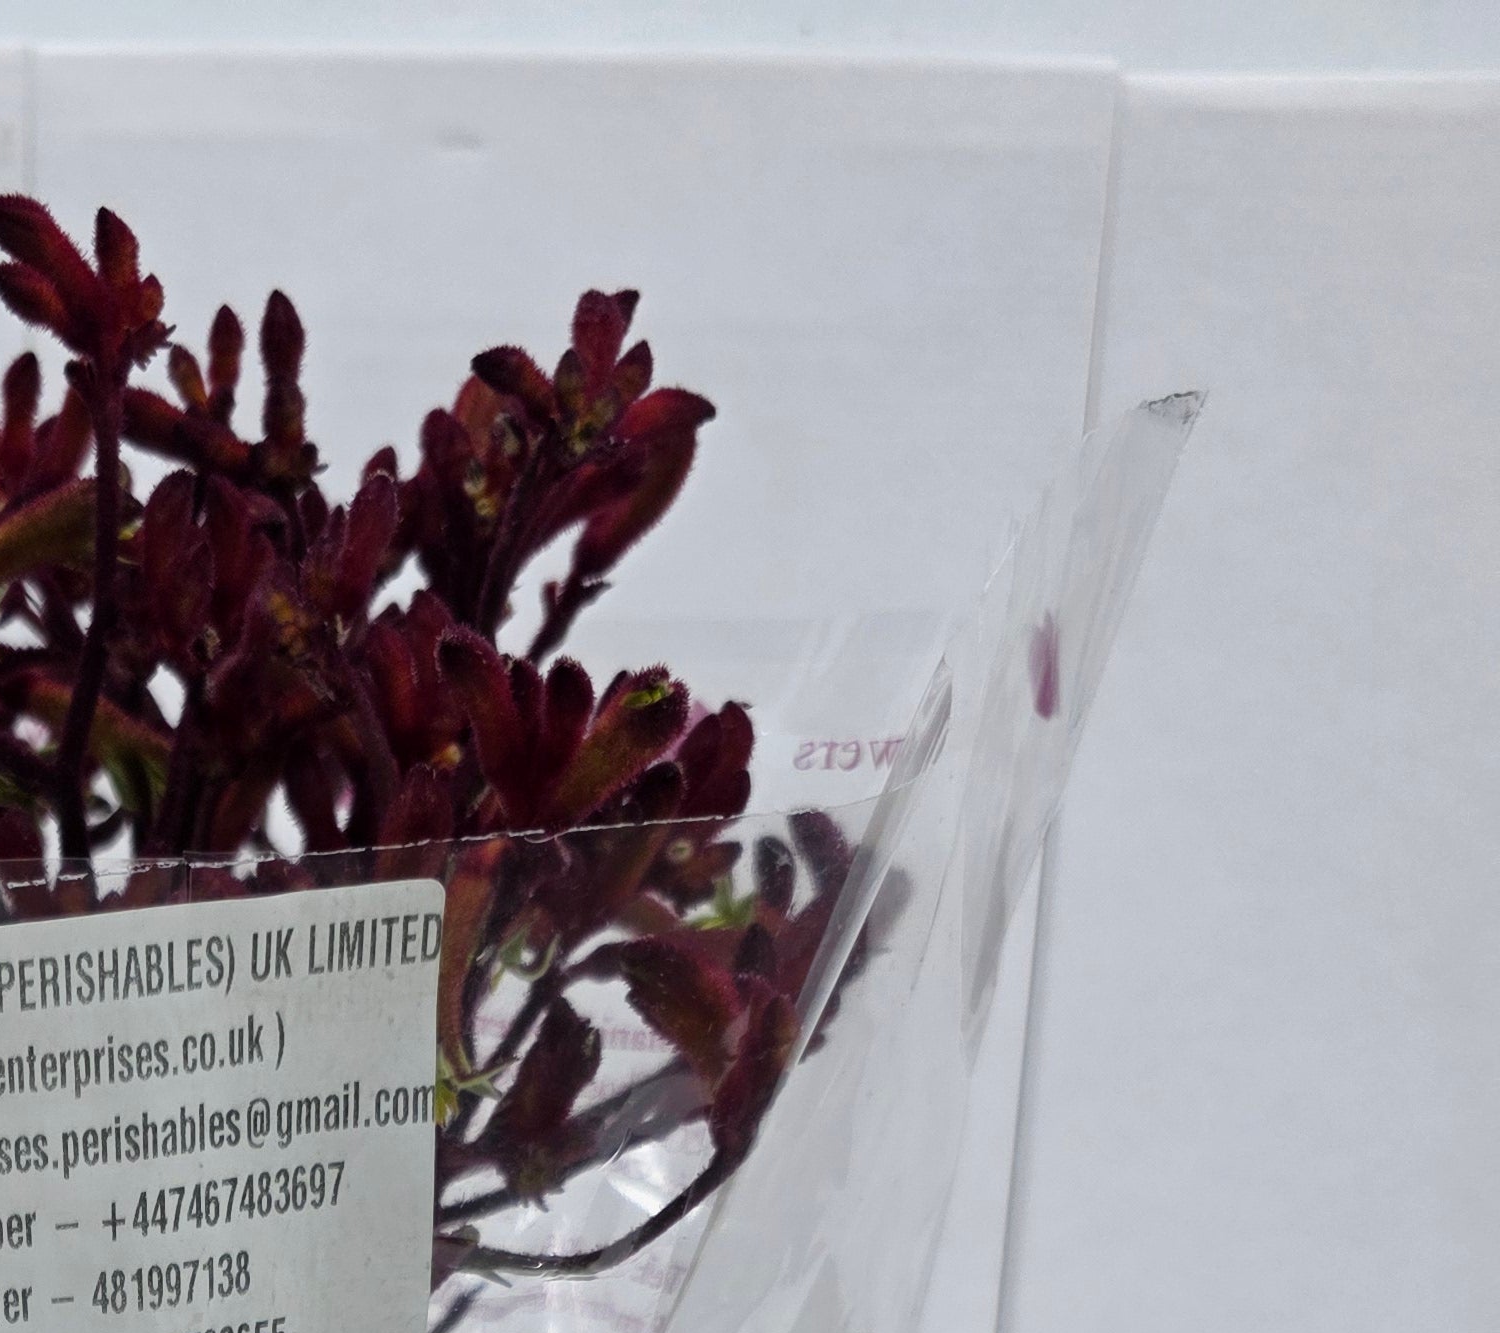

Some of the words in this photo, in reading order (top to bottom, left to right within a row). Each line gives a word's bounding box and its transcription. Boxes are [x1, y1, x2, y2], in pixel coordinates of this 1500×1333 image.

[251, 931, 296, 981] UK
[309, 912, 442, 976] LIMITED
[276, 1011, 284, 1070] )
[102, 1161, 345, 1241] +447467483697
[93, 1250, 250, 1314] 481997138
